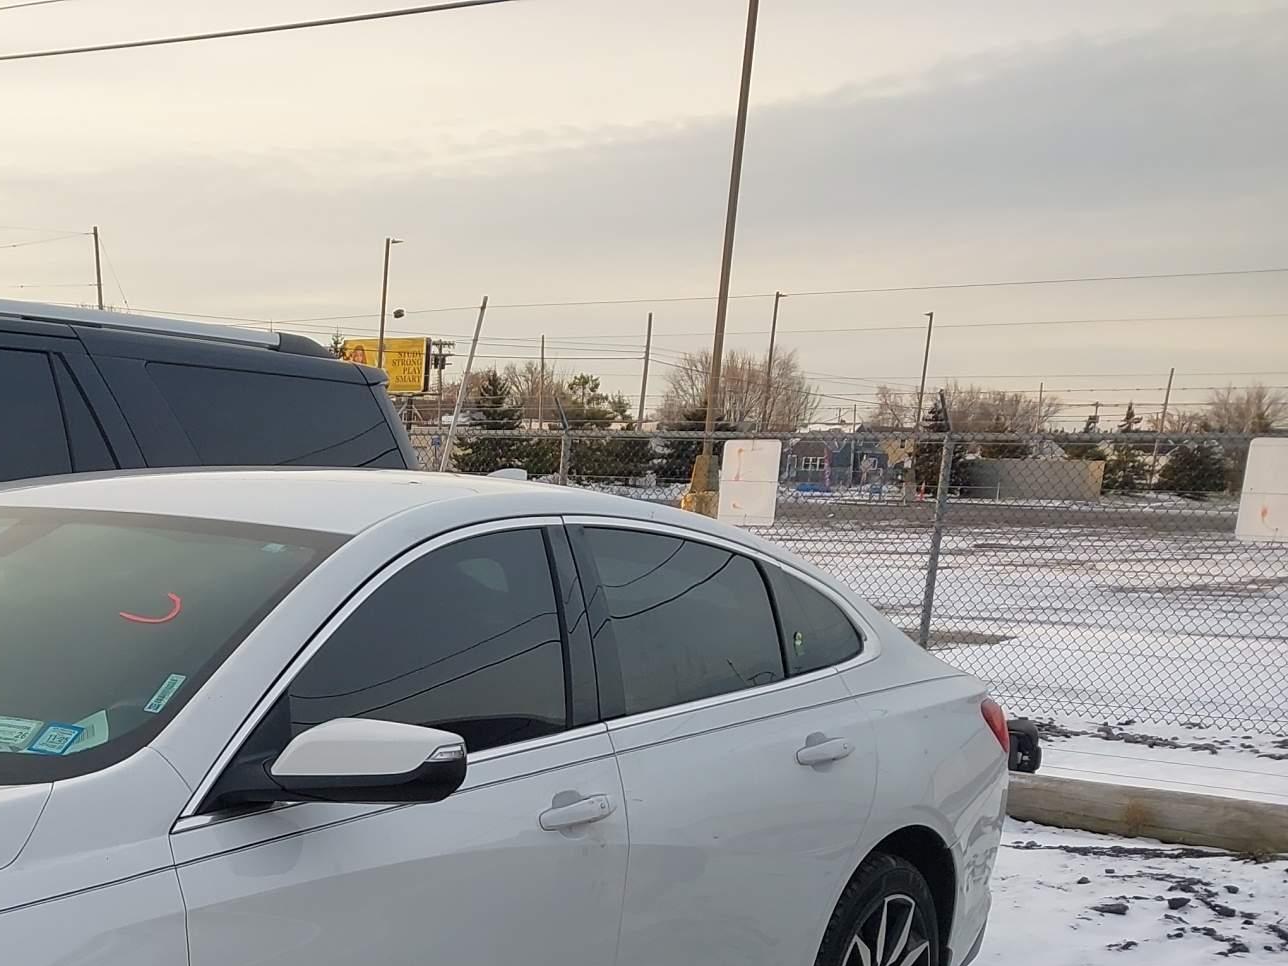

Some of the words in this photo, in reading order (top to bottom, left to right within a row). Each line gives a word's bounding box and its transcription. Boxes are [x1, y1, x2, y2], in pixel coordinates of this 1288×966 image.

[398, 350, 422, 358] STUDY
[392, 359, 422, 367] STRONG
[403, 367, 422, 375] PLAY
[395, 375, 421, 383] SMART
